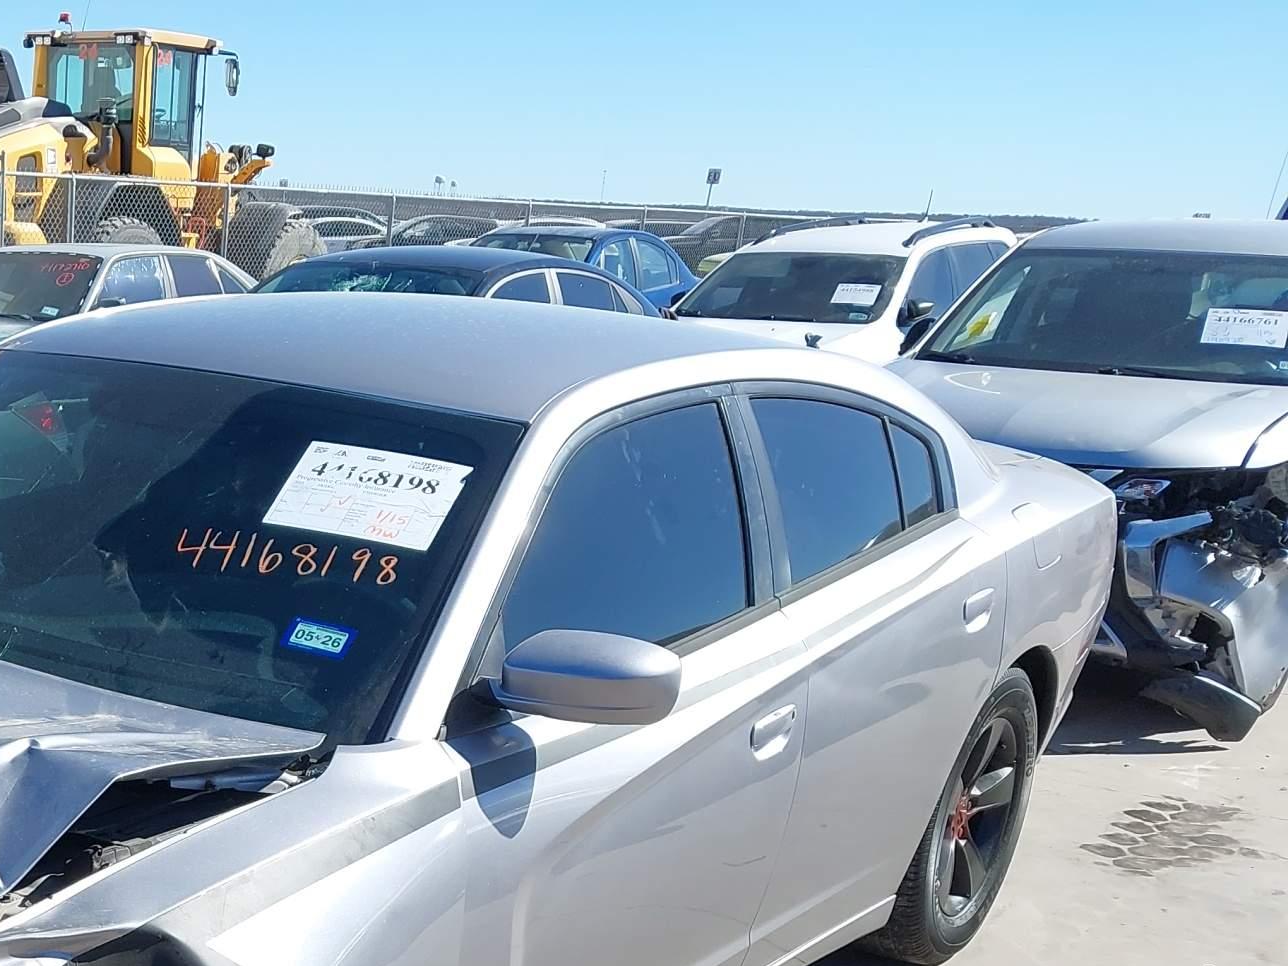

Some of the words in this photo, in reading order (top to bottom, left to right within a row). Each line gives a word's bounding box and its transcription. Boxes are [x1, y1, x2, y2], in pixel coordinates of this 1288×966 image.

[176, 527, 399, 586] 44168198
[294, 628, 316, 642] 05
[320, 634, 342, 648] 26
